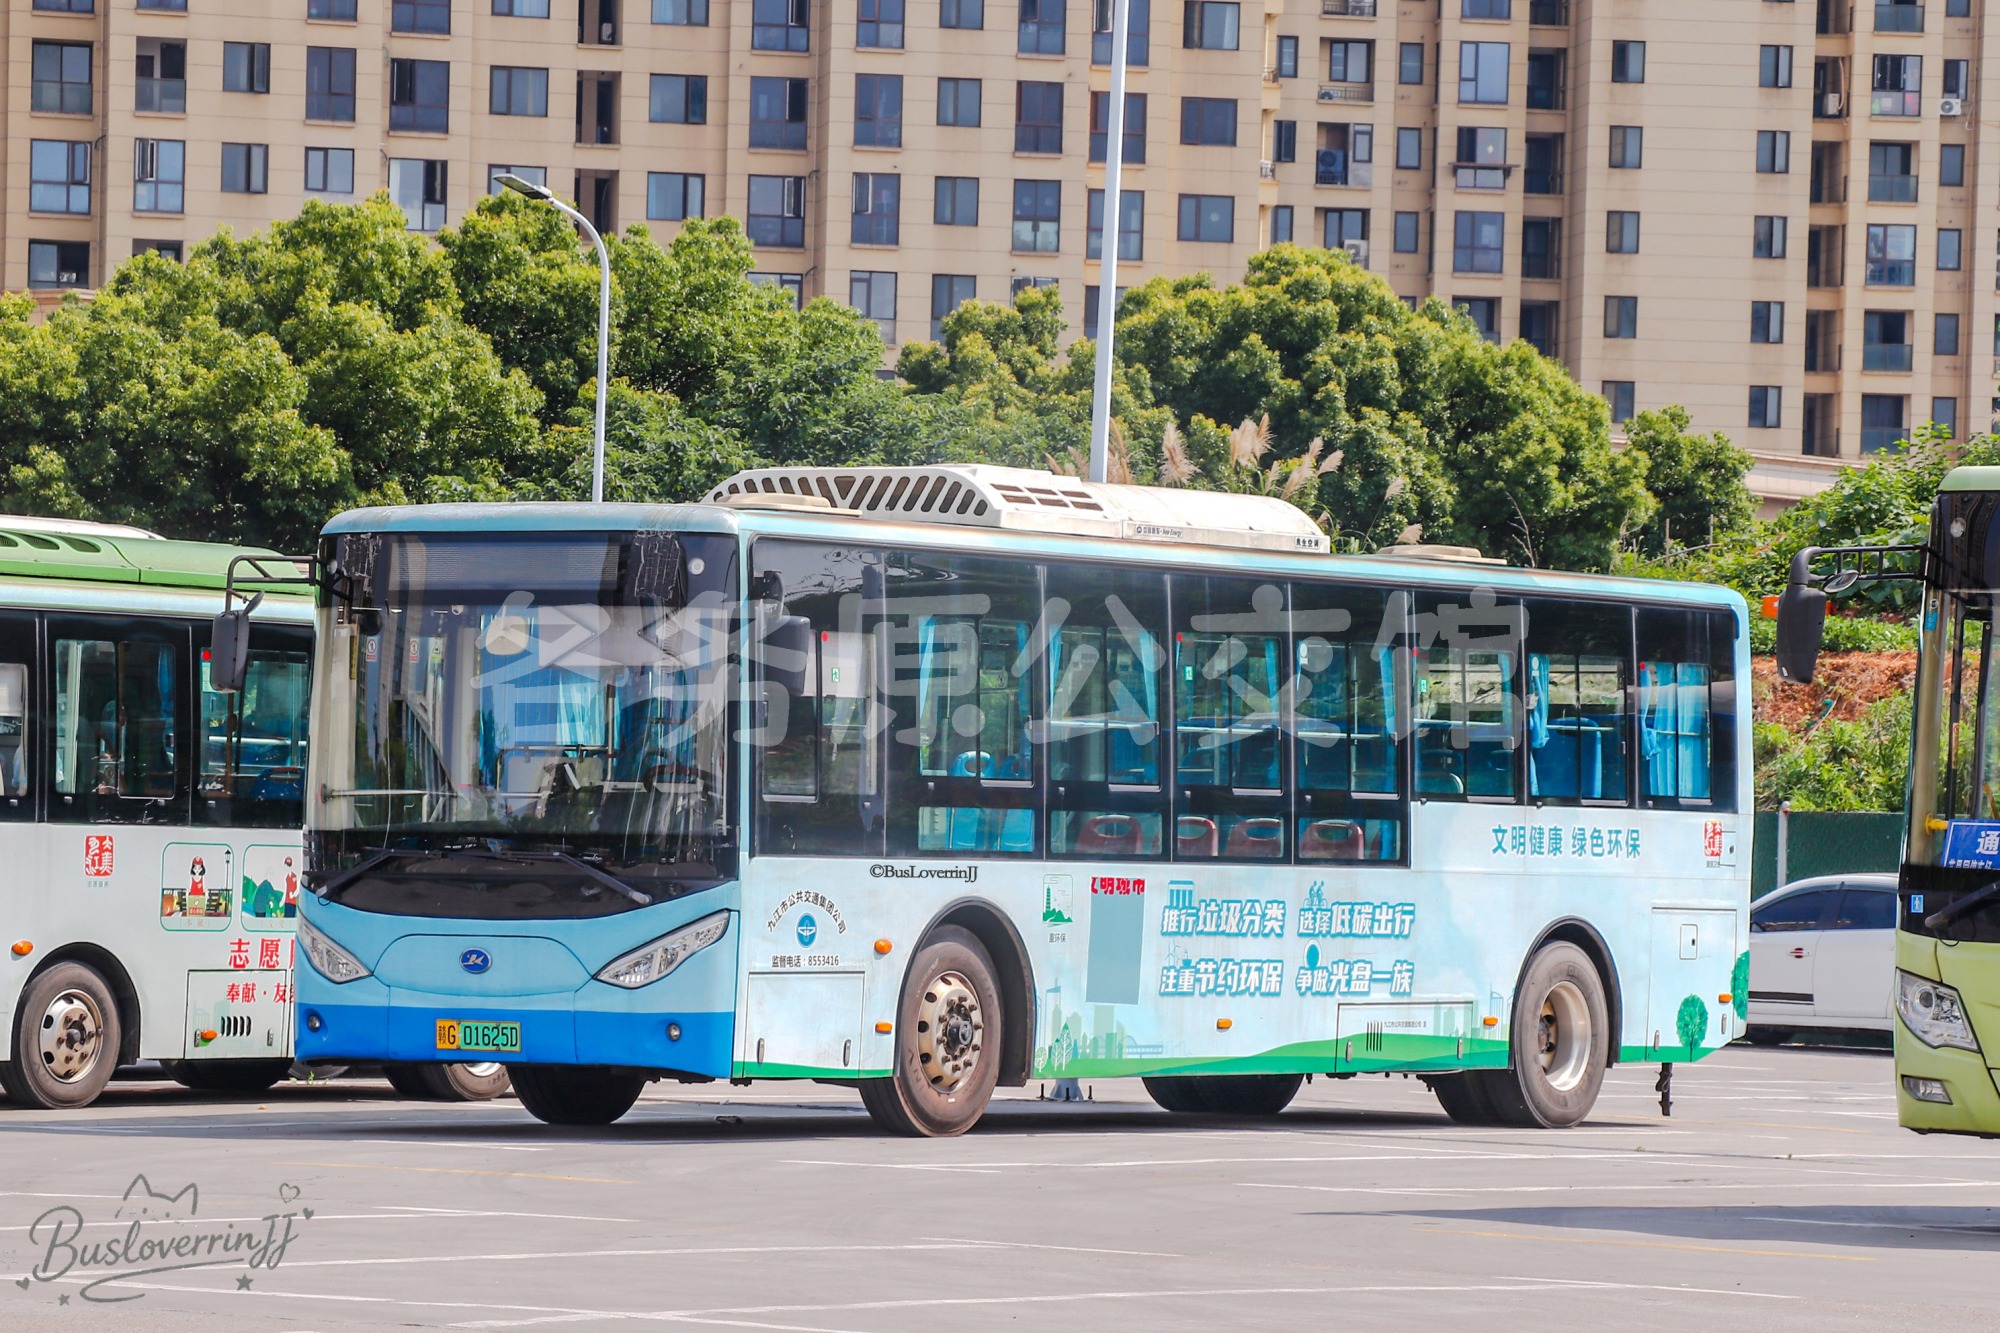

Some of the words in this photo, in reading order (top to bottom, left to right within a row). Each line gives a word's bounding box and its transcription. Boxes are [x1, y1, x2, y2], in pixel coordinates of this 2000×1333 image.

[1492, 824, 1563, 857] 文明健康
[1571, 827, 1641, 859] 绿色环保
[766, 889, 847, 934] 九江市公共交通集团公司
[1161, 900, 1286, 938] 推行垃圾分类
[1299, 901, 1415, 938] 选择低碳出行
[228, 938, 296, 969] 志愿
[1160, 959, 1283, 996] 注重节约环保
[1296, 959, 1414, 996] 争做光盘一族
